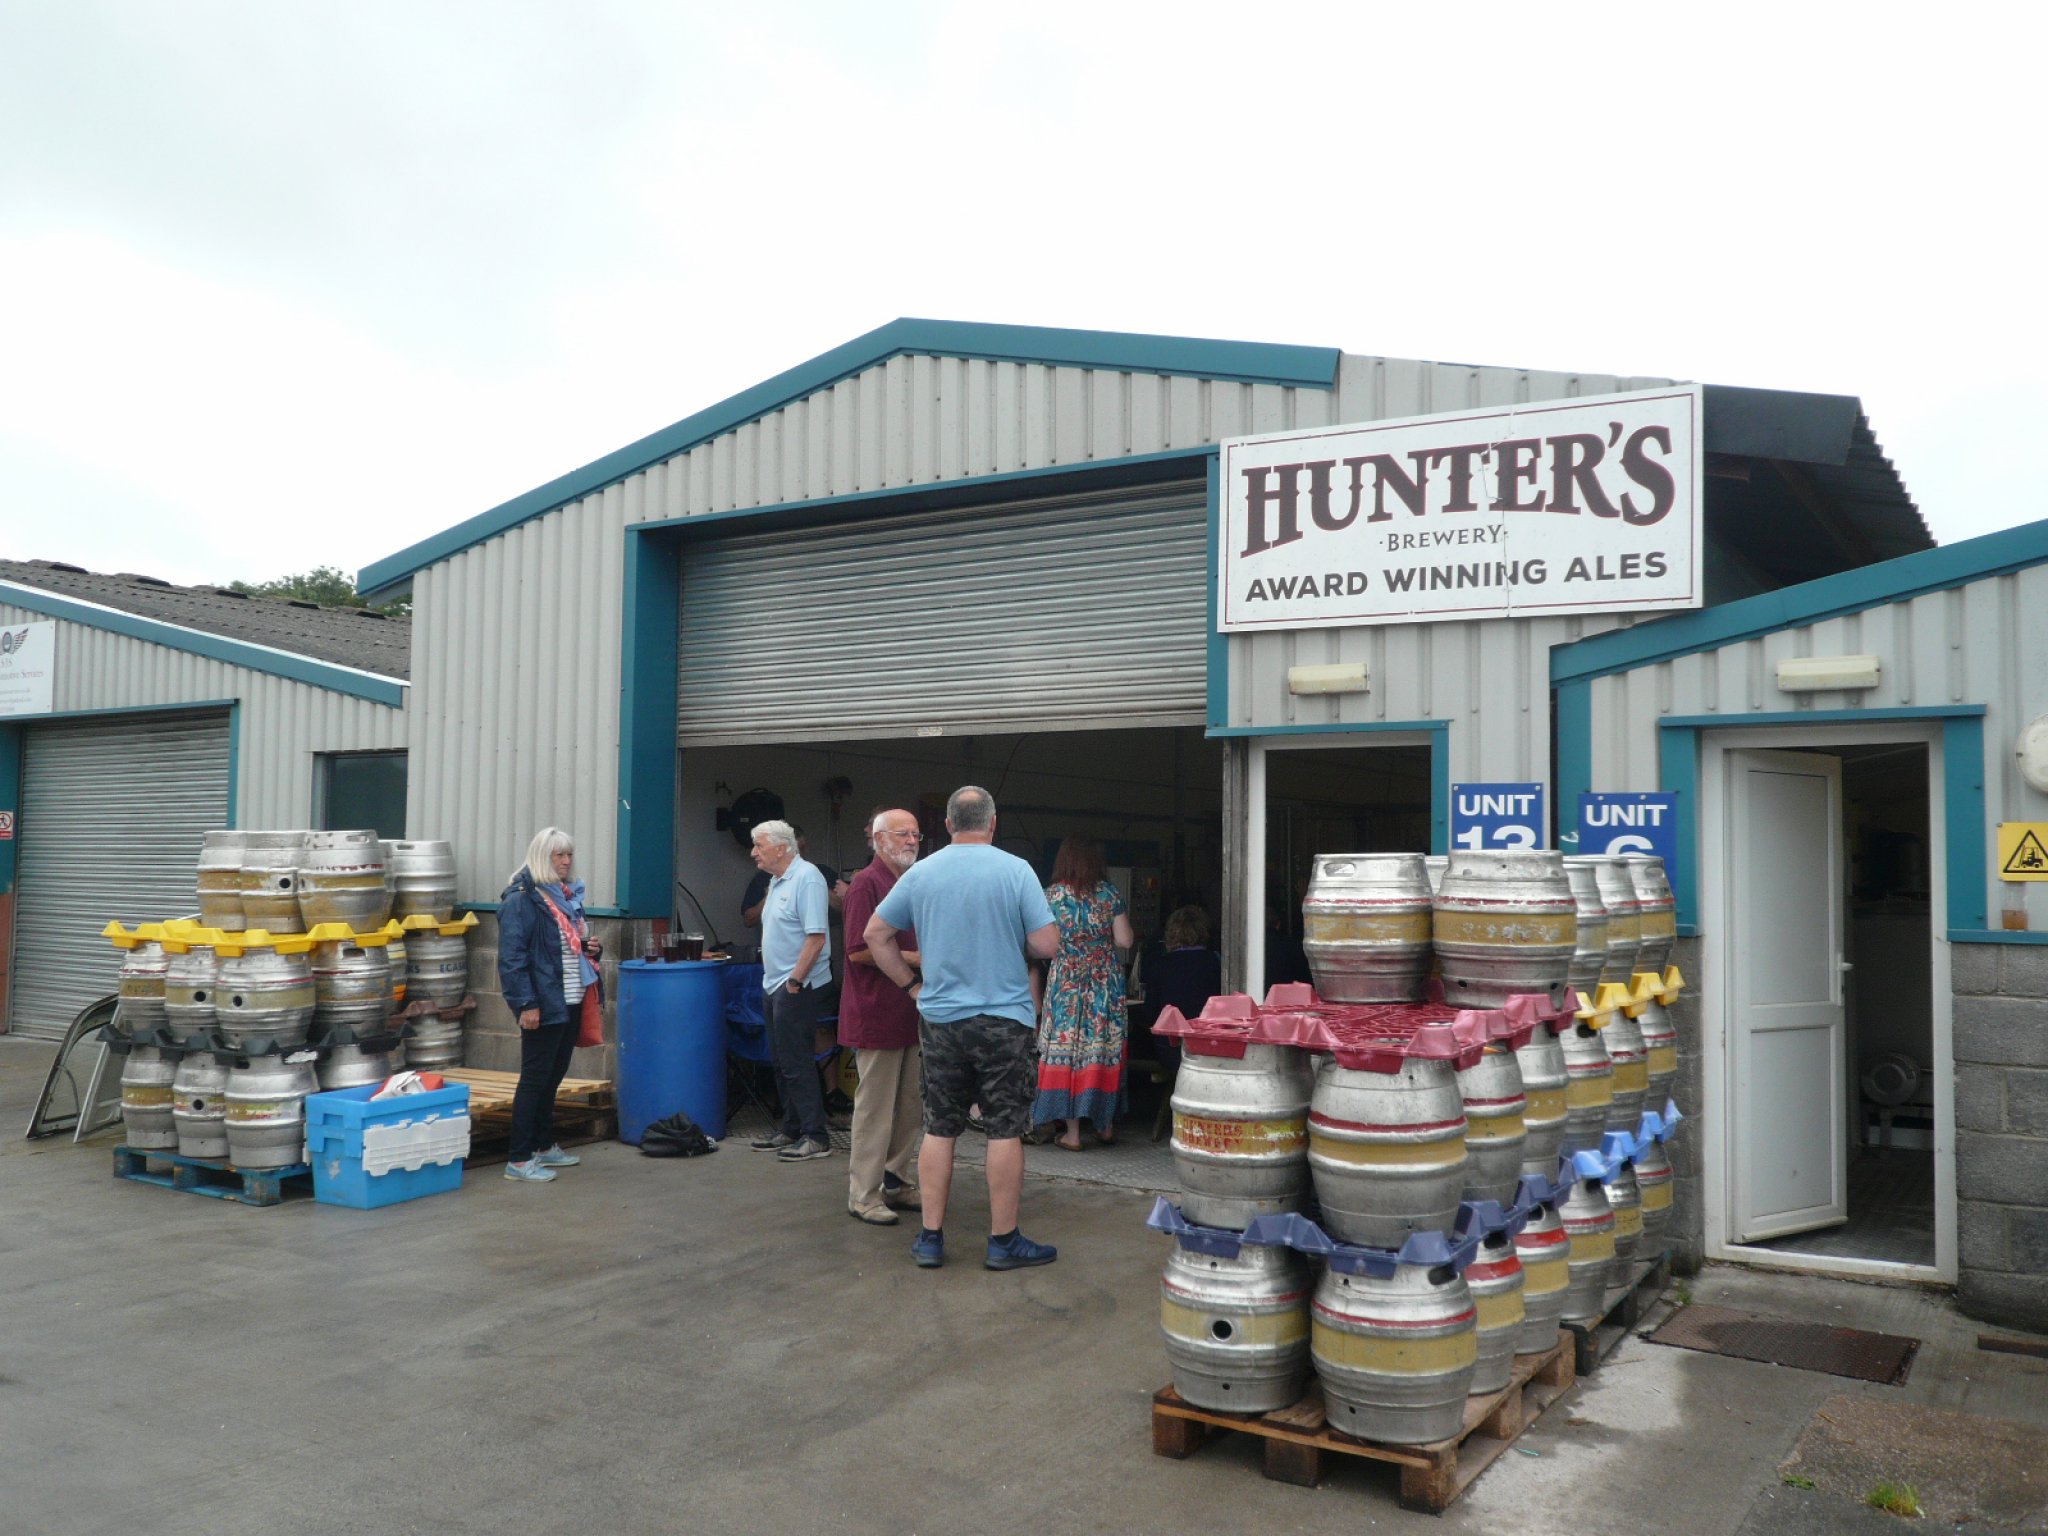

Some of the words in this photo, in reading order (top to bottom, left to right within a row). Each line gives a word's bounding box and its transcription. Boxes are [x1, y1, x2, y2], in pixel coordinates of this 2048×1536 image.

[1240, 422, 1676, 559] HUNTER'S
[1386, 524, 1503, 552] BREWERY
[1245, 571, 1368, 602] AWARD
[1383, 558, 1547, 592] WINNING
[1563, 551, 1668, 583] ALES
[1458, 794, 1536, 816] UNIT
[1585, 804, 1668, 826] UNIT
[1457, 825, 1537, 850] 13
